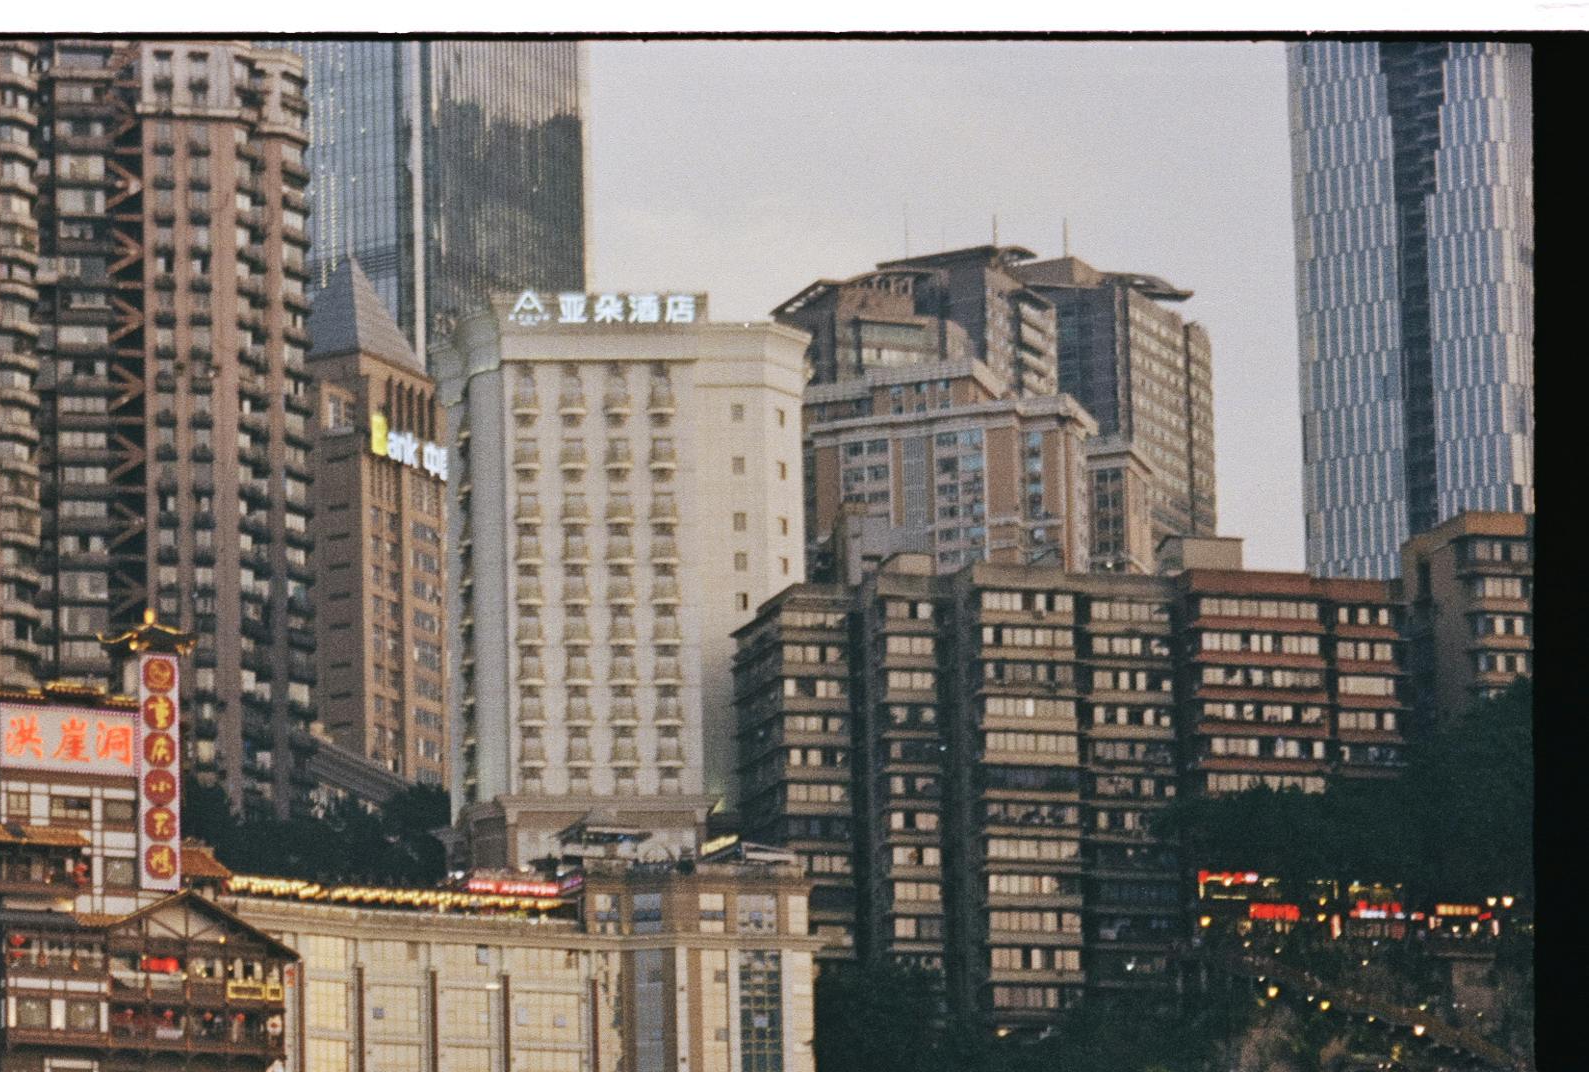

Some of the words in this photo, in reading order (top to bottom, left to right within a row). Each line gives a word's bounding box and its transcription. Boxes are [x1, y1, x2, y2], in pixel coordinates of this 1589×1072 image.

[558, 292, 696, 324] 亚朵酒店
[5, 714, 134, 767] 洪崖洞
[148, 694, 175, 873] 重庆小天鹅
